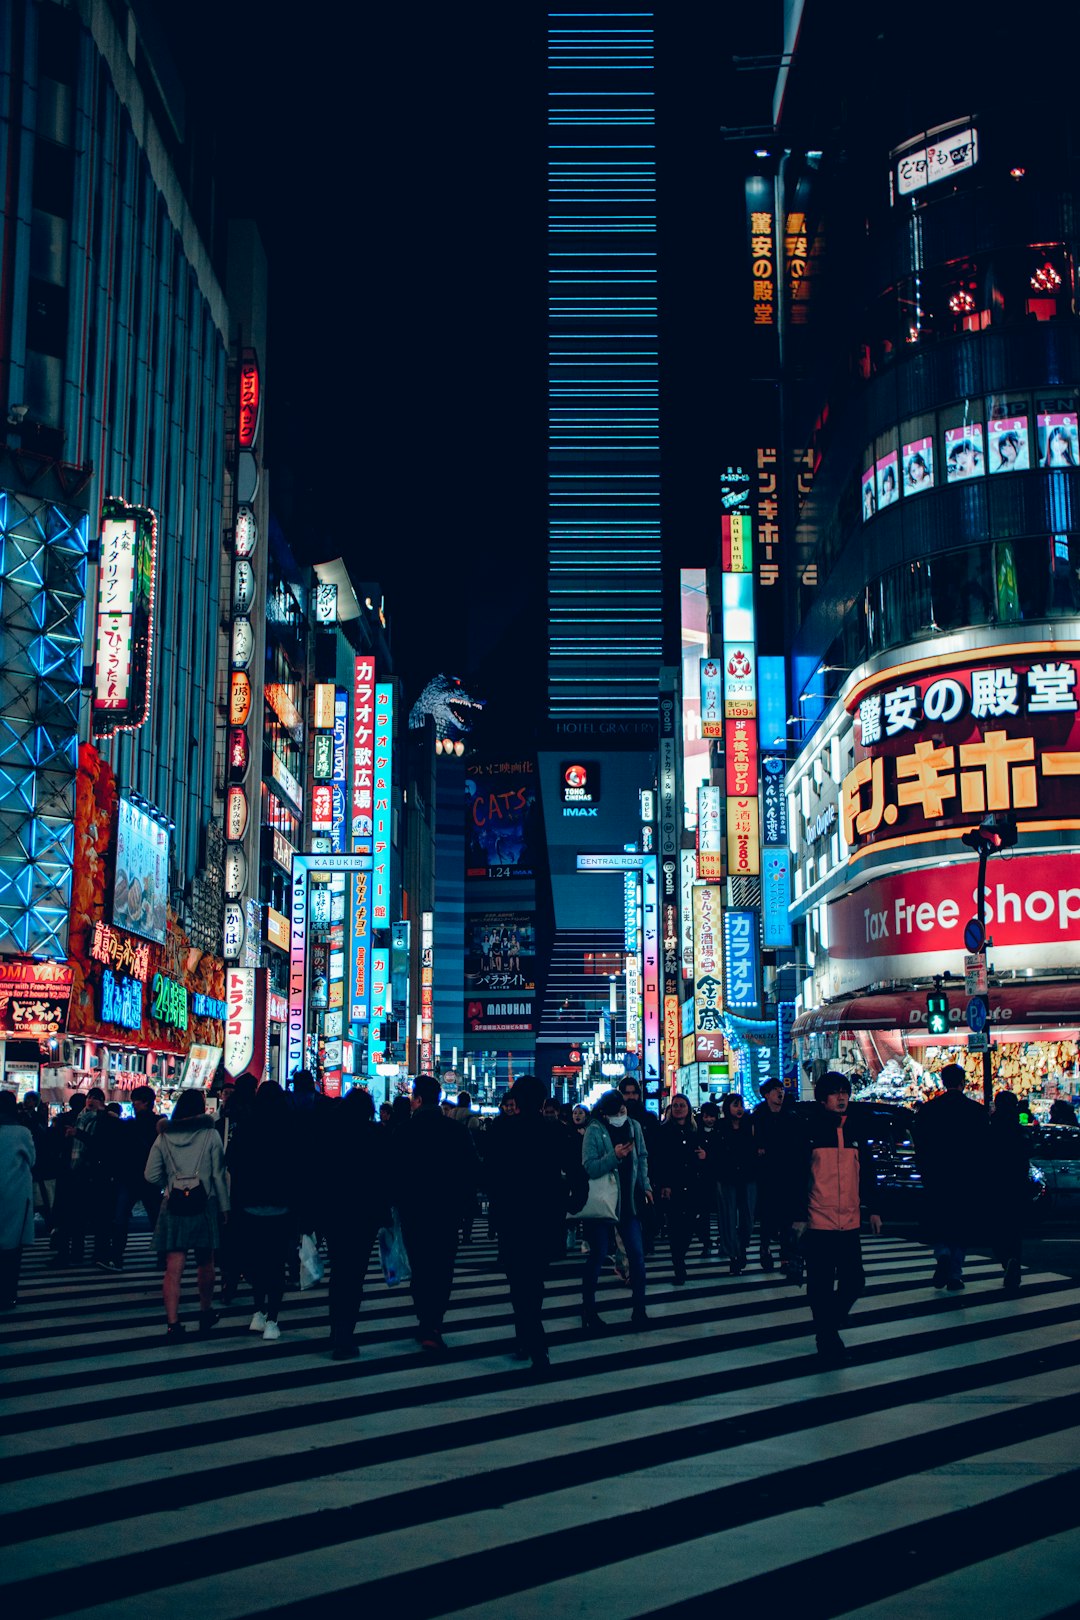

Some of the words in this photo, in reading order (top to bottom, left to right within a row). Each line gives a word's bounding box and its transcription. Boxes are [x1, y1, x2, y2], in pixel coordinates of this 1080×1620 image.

[751, 212, 773, 325] 驚安の殿堂
[756, 447, 779, 585] ドン・キホーテ
[105, 536, 120, 604] イタリアン
[104, 630, 122, 697] ひょうたん
[105, 699, 118, 708] 7F
[859, 662, 1077, 746] 驚安の殿堂
[353, 662, 372, 810] カラオケ歌広場
[556, 723, 598, 733] HOTEL
[472, 786, 526, 827] CATS
[562, 807, 598, 817] IMAX
[565, 788, 585, 796] TOHO
[314, 859, 363, 867] KABUKI町
[487, 867, 510, 878] 1.24
[739, 841, 748, 869] 280
[356, 873, 366, 904] ツモト
[662, 861, 675, 894] Booth
[701, 889, 713, 957] きんくら酒場
[864, 908, 889, 941] Tax
[894, 898, 959, 933] Free
[290, 890, 305, 995] GODZILLA
[732, 916, 752, 996] カラオケ
[32, 965, 72, 981] YAKI
[476, 973, 525, 987] パラサイト
[644, 904, 656, 1047] ゴジラロード
[229, 974, 242, 1035] トラノコ
[487, 1003, 531, 1015] MARUHAN
[289, 1009, 302, 1060] ROAD
[698, 1037, 714, 1051] 2F
